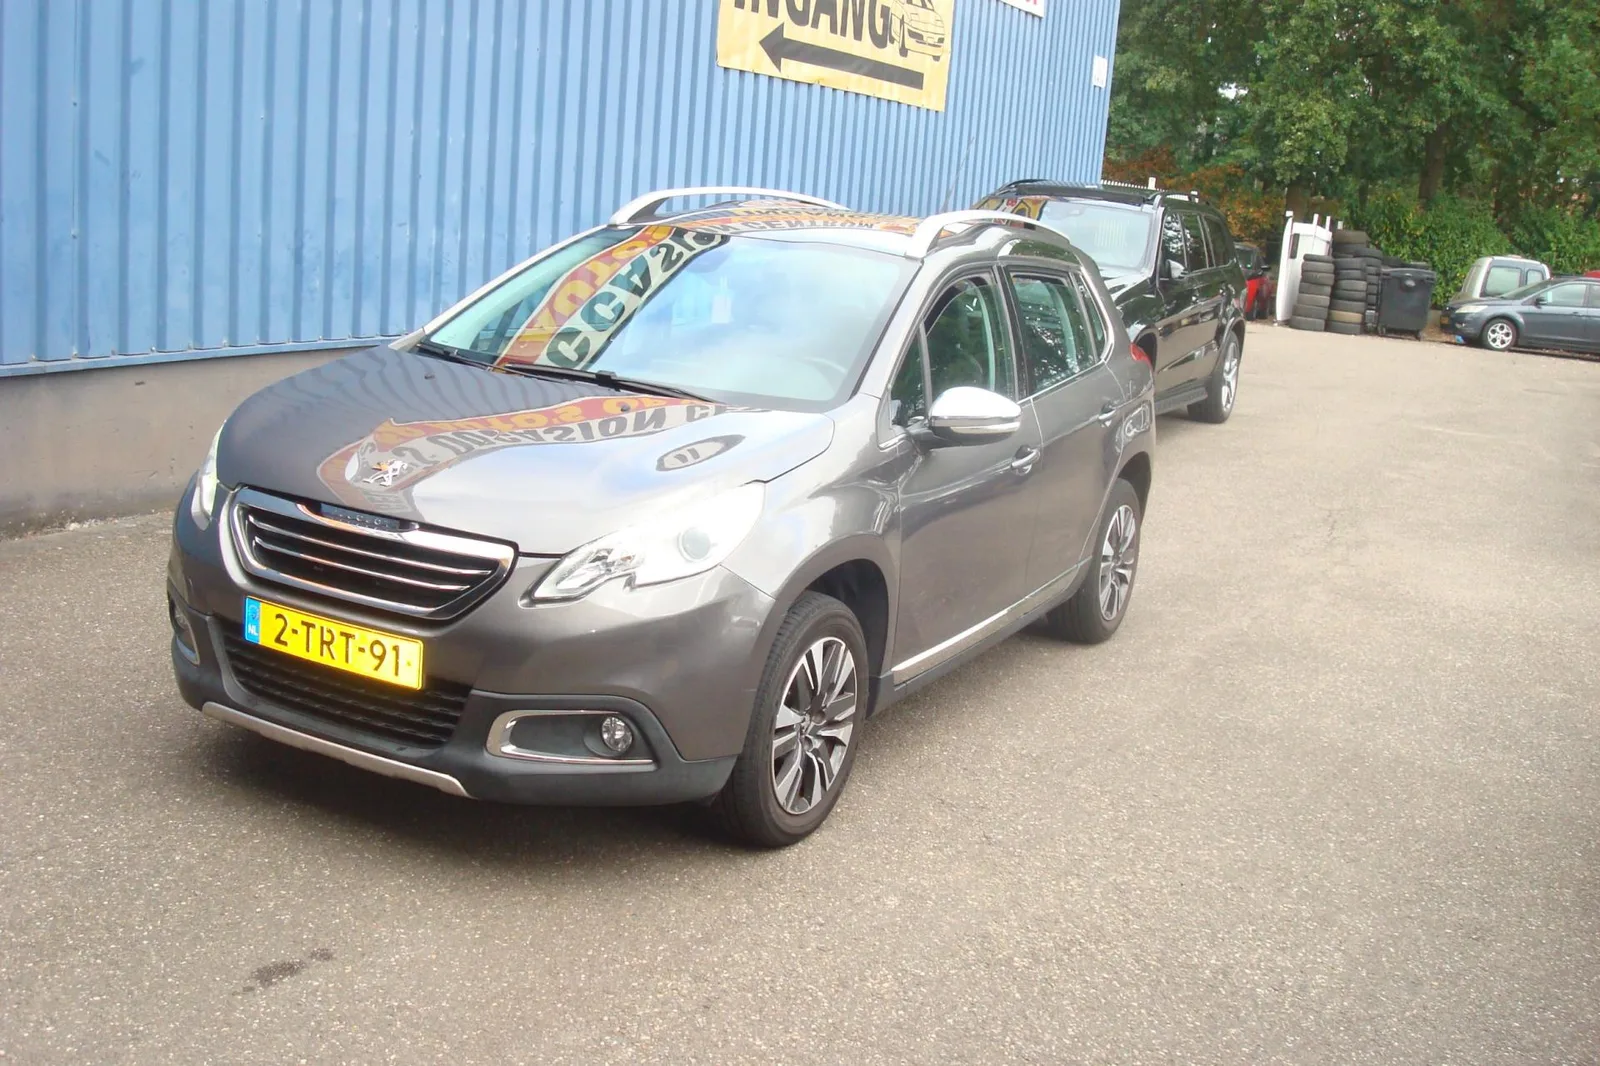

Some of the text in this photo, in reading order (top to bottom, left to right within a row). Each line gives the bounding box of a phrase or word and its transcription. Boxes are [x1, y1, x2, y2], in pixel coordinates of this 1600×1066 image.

[734, 0, 891, 49] GANG
[248, 624, 259, 637] NL
[273, 613, 400, 677] 2-TRT-91
